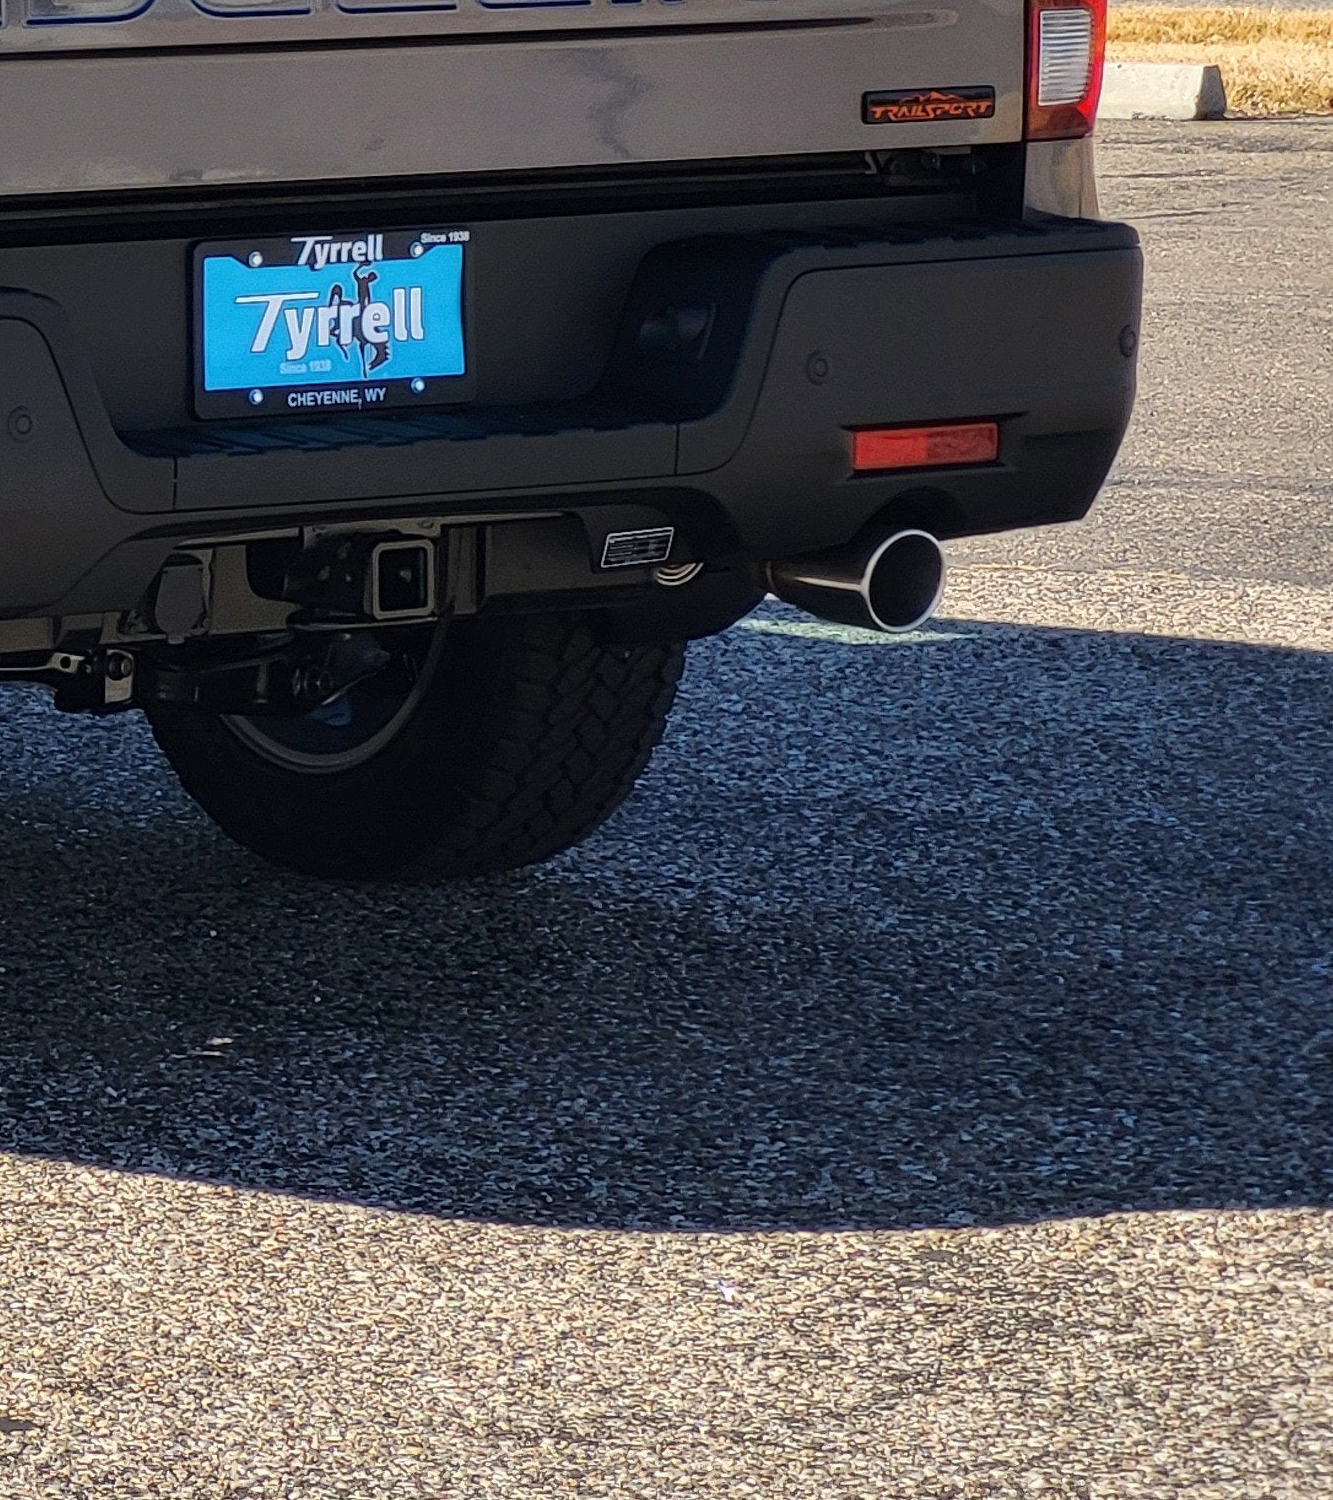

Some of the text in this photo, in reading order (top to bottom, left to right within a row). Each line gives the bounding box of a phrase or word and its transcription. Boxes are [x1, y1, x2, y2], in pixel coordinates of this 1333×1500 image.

[871, 100, 993, 122] TRAILSPORT
[291, 233, 384, 269] Tyrrell
[235, 286, 425, 361] Tyrrell
[287, 387, 387, 409] CHEYENNE, WY
